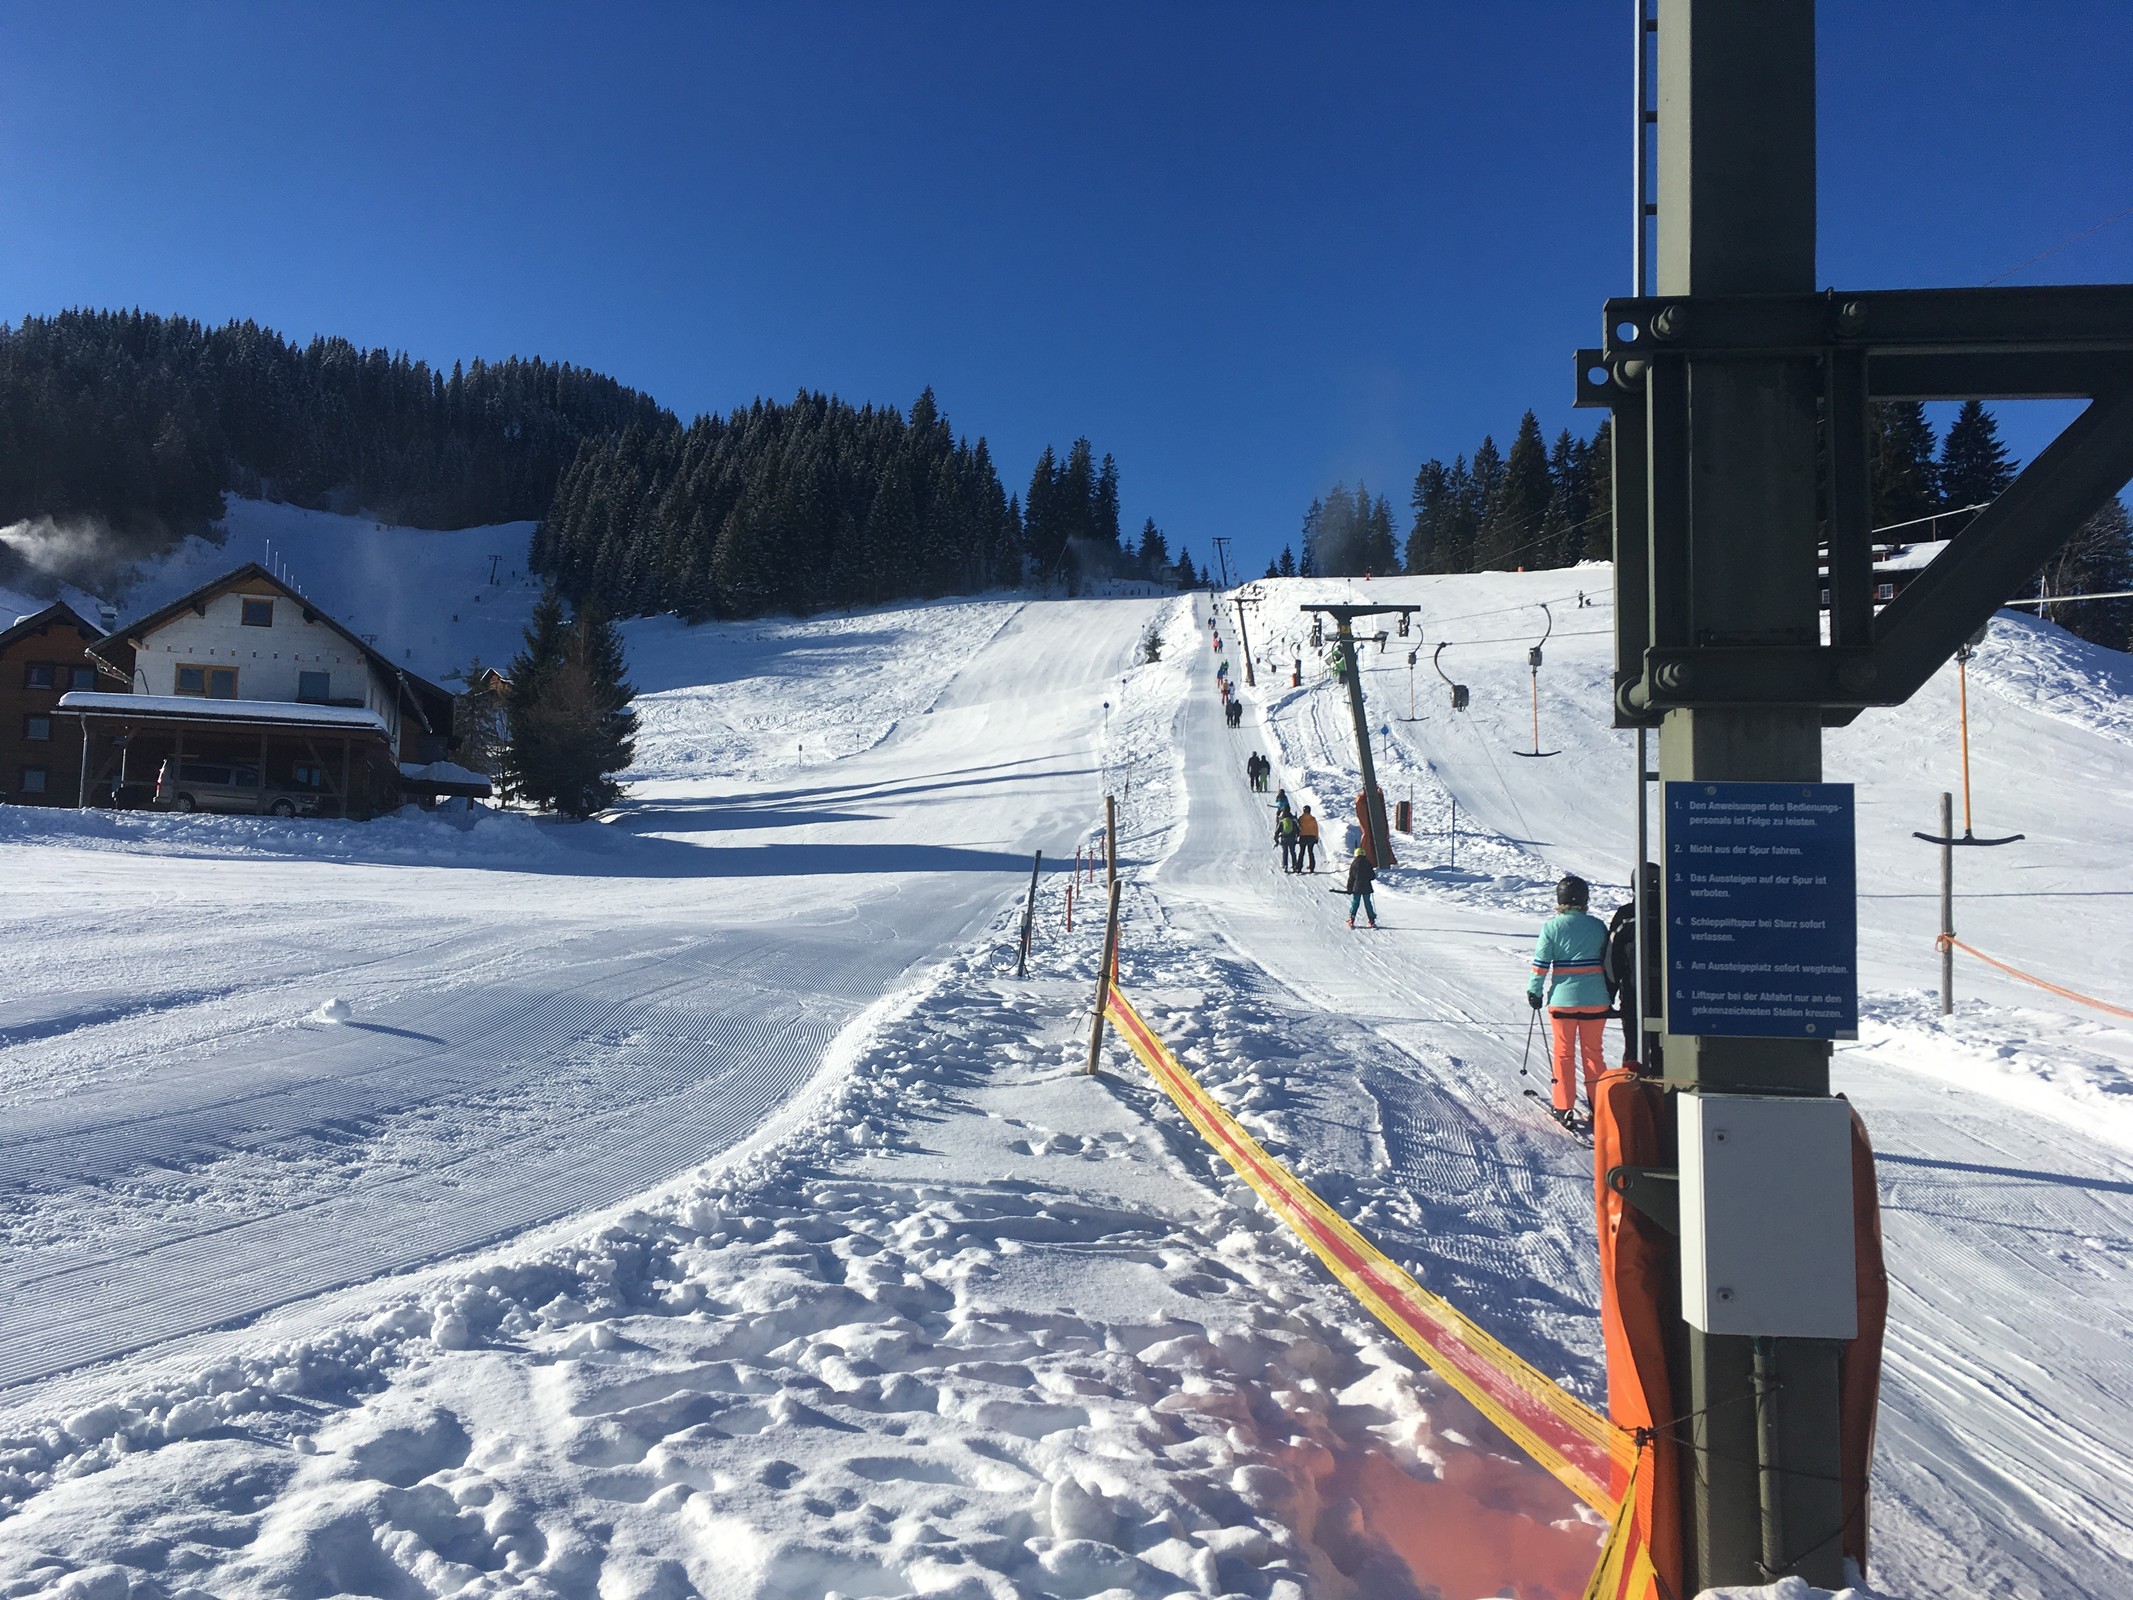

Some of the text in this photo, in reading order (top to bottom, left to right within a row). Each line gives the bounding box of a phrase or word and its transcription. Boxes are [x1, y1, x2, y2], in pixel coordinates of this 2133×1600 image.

[1675, 801, 1842, 813] 1. Den Anweisungen des Bedienungs-
[1690, 816, 1732, 825] personals
[1734, 817, 1745, 825] ist
[1747, 816, 1771, 827] Folge
[1785, 817, 1817, 826] leisten.
[1674, 844, 1683, 853] 2.
[1690, 845, 1713, 853] Nicht
[1732, 845, 1747, 854] der
[1749, 846, 1770, 855] Spur
[1772, 846, 1803, 855] fahren.
[1675, 873, 1826, 886] 3. Das Aussteigen auf der Spur ist
[1690, 889, 1731, 897] verboten.
[1675, 917, 1826, 929] 4. Schleppliftspur bei Sturz sofort
[1691, 932, 1735, 941] verlassen.
[1676, 961, 1849, 975] 5. Am Aussteigeplatz sofort wegtreten.
[1676, 990, 1684, 998] 6.
[1692, 990, 1725, 1001] Liftspur
[1728, 992, 1741, 1000] bei
[1743, 992, 1758, 1000] der
[1760, 993, 1792, 1001] Abfahrt
[1825, 994, 1841, 1003] den
[1692, 1006, 1843, 1018] gekennzeichneten Stellen kreuzen.
